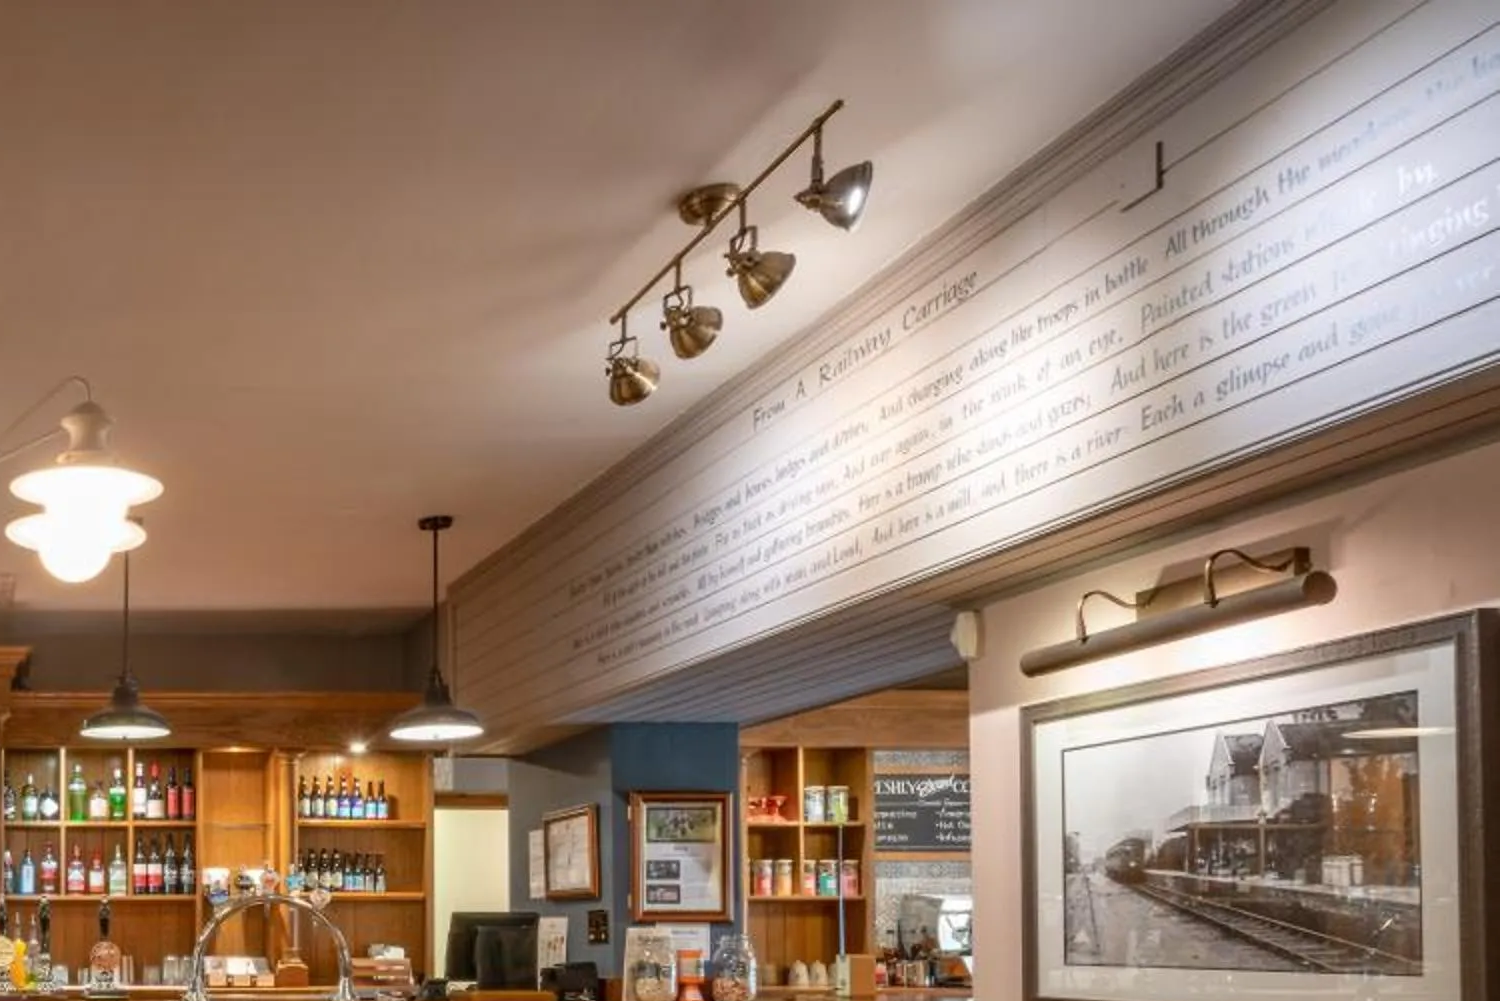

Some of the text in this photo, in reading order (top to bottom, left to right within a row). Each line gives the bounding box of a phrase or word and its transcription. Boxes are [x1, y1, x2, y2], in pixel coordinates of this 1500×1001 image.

[1104, 255, 1149, 295] battle
[1164, 227, 1187, 260] All
[1192, 184, 1270, 246] through
[1277, 163, 1311, 195] the
[753, 271, 978, 433] From A Railway Carriage
[1110, 355, 1147, 397] And
[1153, 343, 1189, 373] here
[1199, 329, 1214, 352] is
[1222, 310, 1252, 340] the
[1140, 270, 1213, 335] Painted
[1141, 393, 1186, 433] Each
[1193, 389, 1205, 409] a
[1215, 352, 1291, 403] glimpse
[1297, 320, 1339, 363] and
